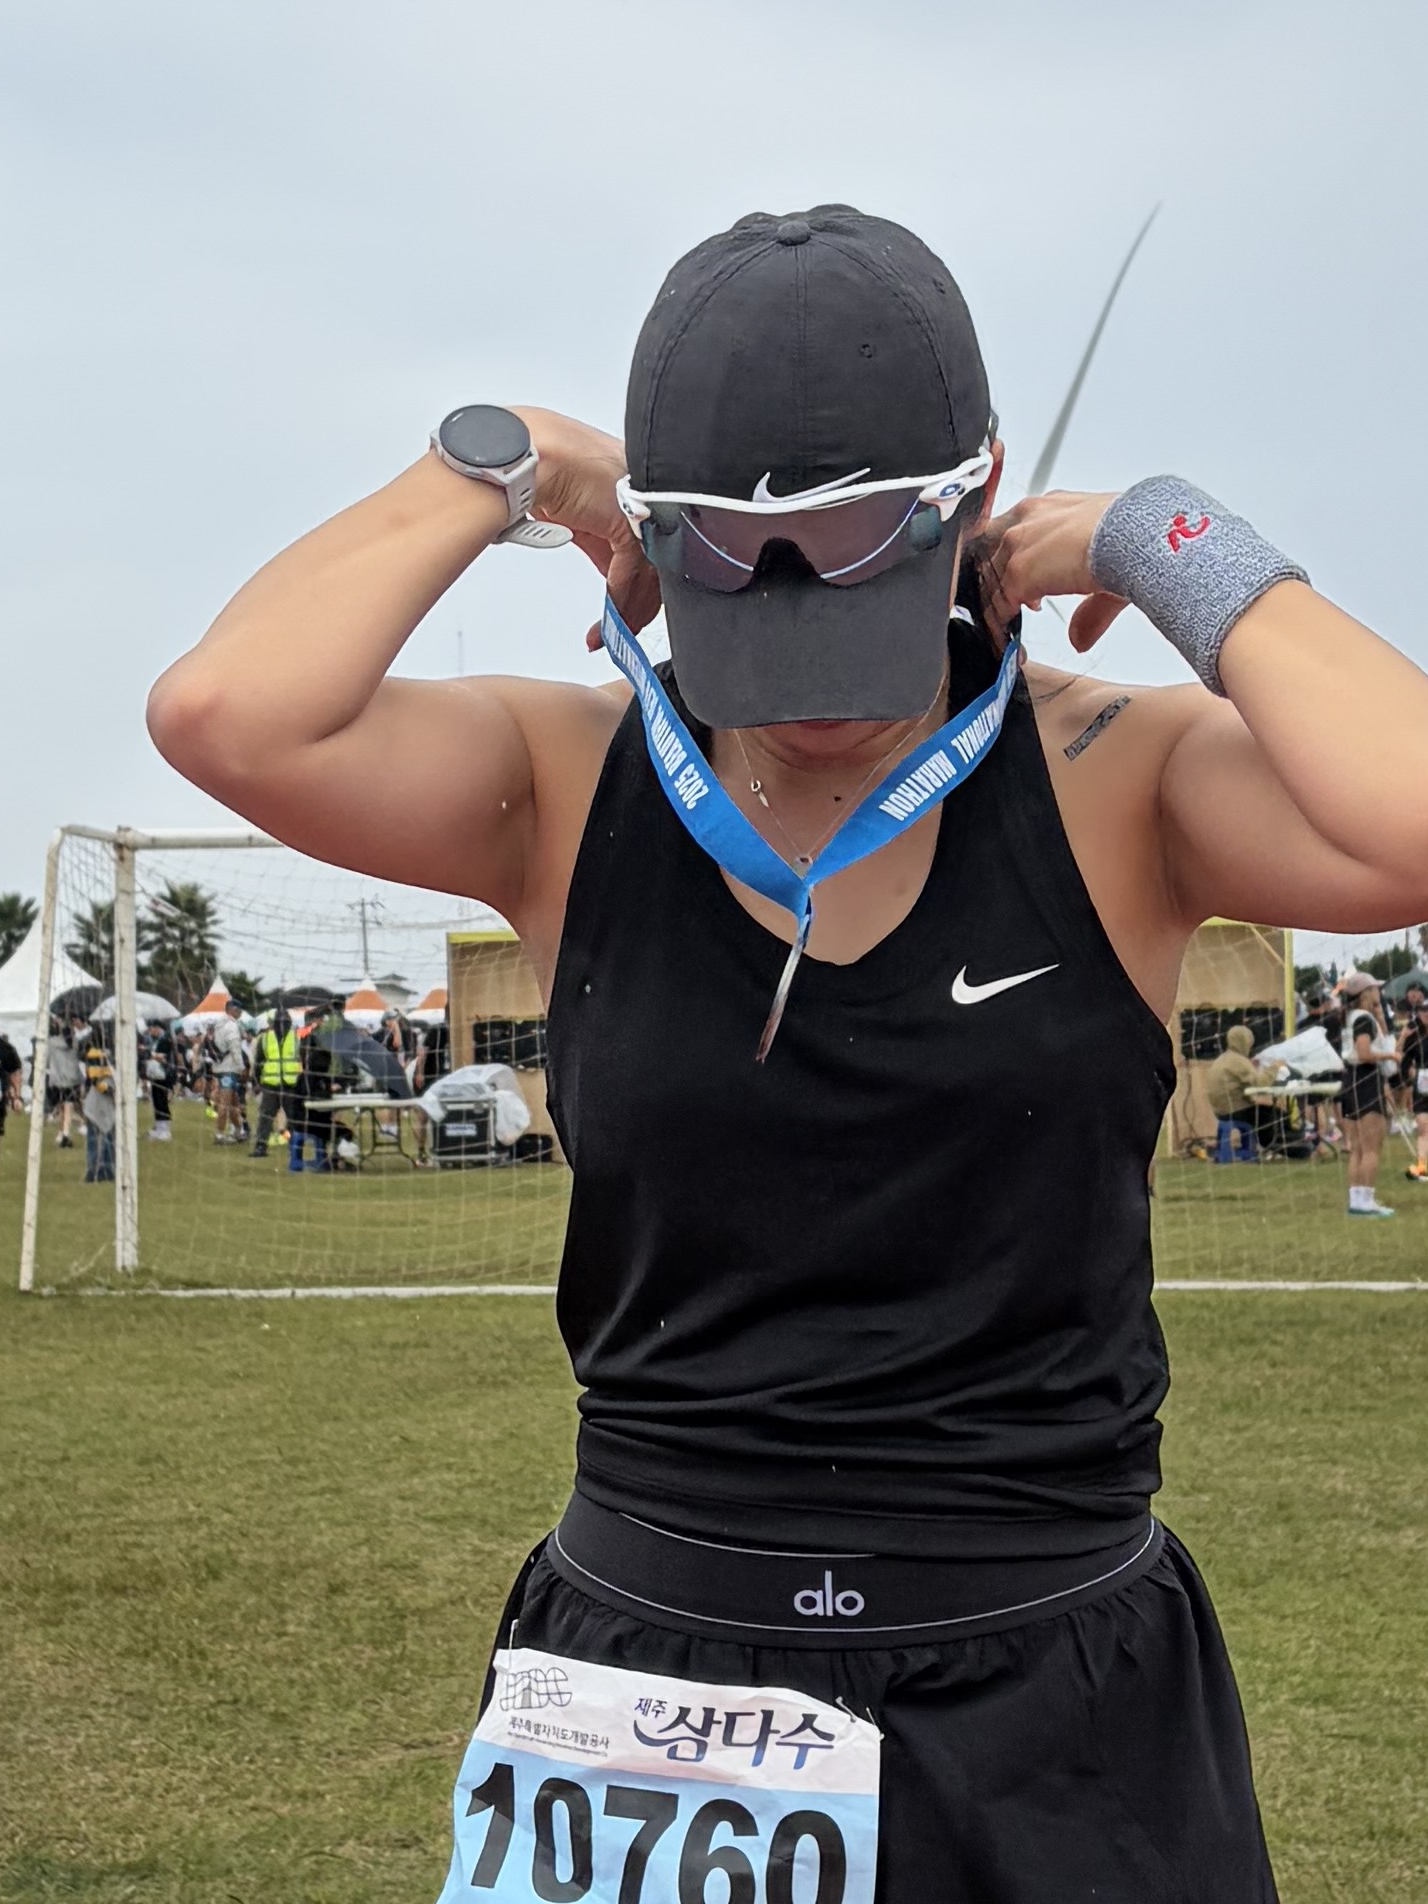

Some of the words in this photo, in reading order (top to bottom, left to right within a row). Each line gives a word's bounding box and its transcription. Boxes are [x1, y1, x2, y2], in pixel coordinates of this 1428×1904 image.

[674, 762, 709, 810] 2025
[879, 749, 957, 822] MARATHON
[793, 1570, 865, 1617] alo
[633, 1697, 667, 1718] 제주
[656, 1706, 836, 1771] 삼다수
